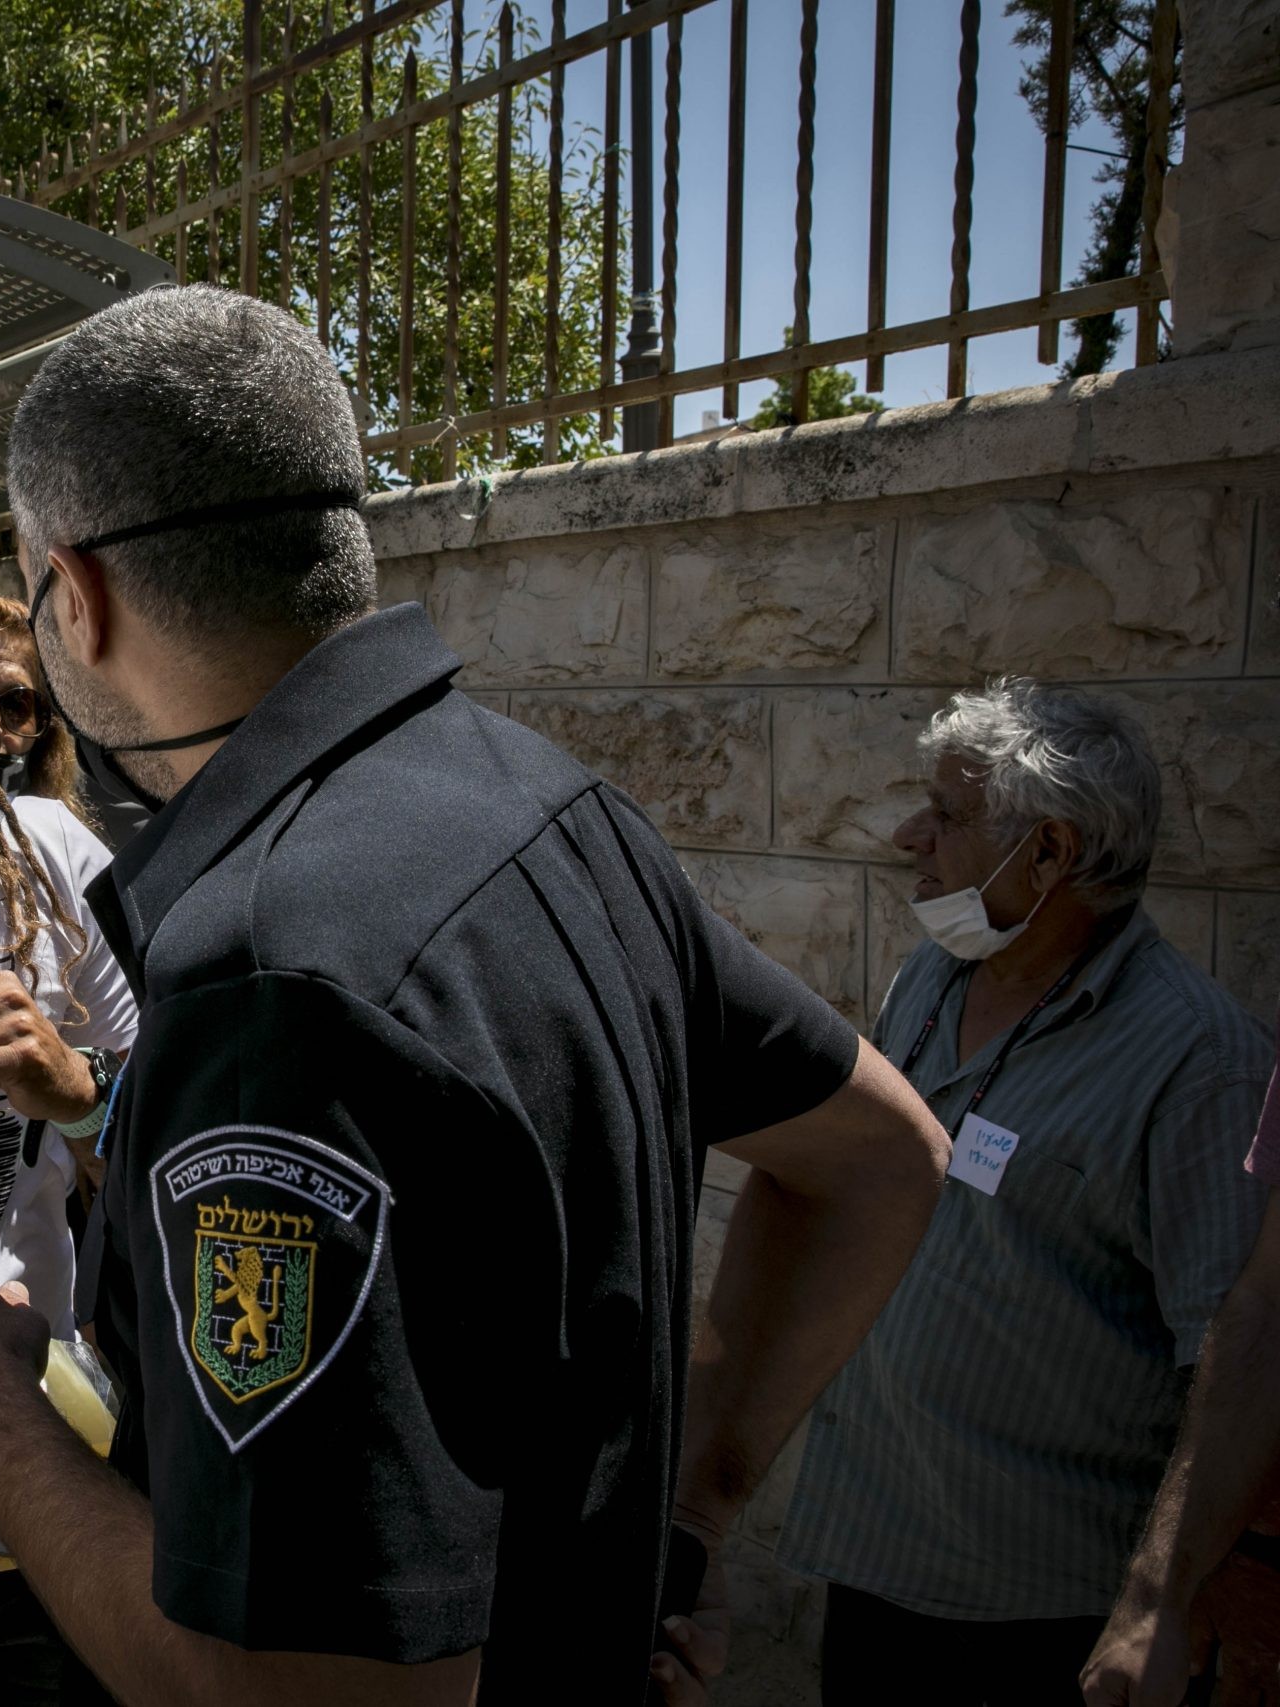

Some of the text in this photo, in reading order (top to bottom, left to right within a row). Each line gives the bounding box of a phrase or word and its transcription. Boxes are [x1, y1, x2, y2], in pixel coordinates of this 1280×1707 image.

[173, 1154, 351, 1210] אגף אכיפה ושיטור
[197, 1194, 314, 1239] ירושלים
